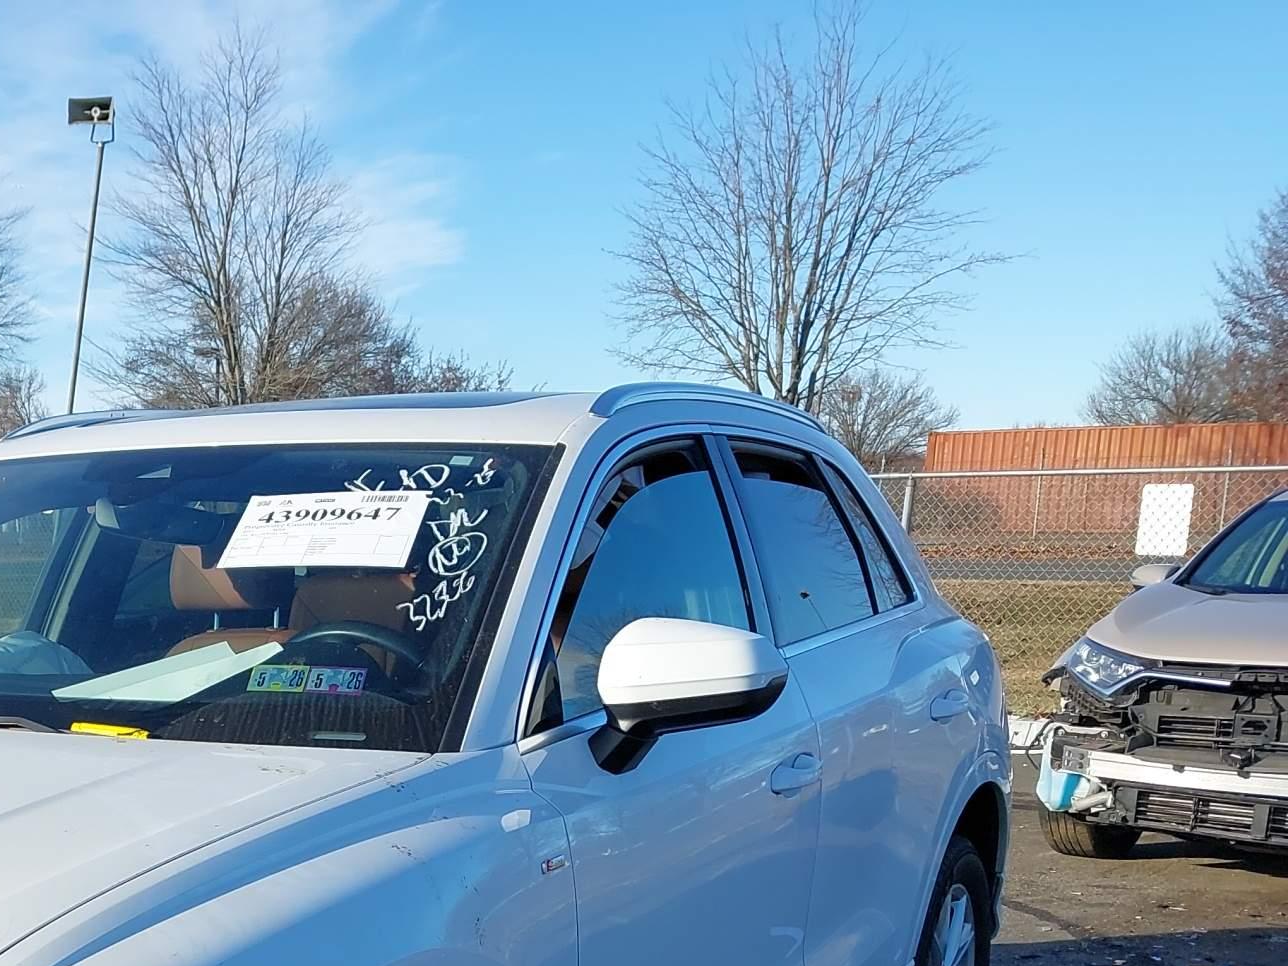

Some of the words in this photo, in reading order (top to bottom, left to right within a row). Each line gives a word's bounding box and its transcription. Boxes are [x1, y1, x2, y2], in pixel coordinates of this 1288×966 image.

[258, 507, 402, 524] 43909647
[256, 671, 268, 688] 5
[288, 669, 306, 688] 26
[314, 672, 325, 689] 5
[345, 671, 364, 690] 26
